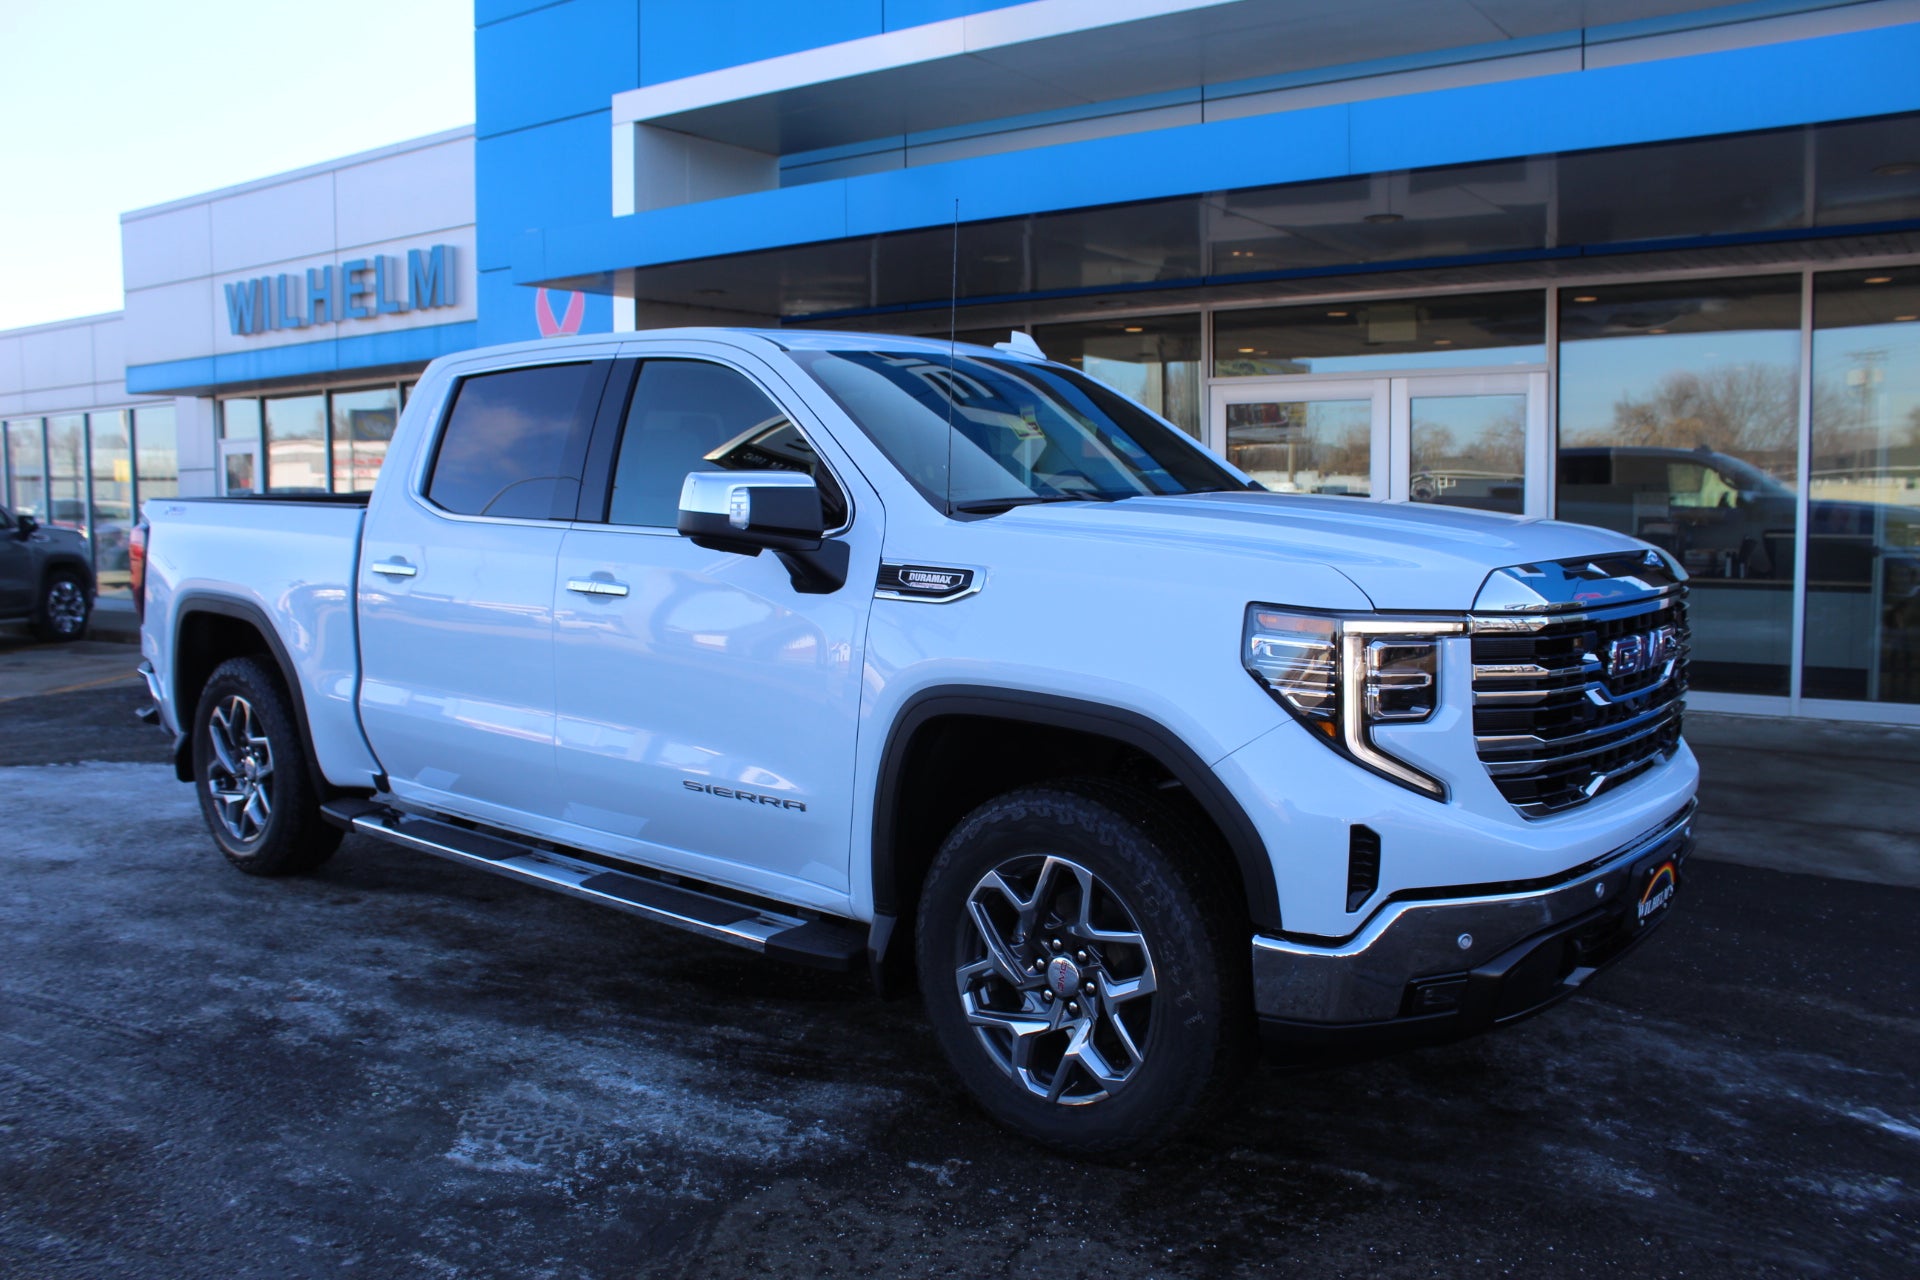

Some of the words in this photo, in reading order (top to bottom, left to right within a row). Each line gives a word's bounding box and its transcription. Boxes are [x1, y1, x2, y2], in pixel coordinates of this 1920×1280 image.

[224, 244, 456, 336] WILHELM
[908, 572, 952, 585] DURAMAX
[1608, 625, 1678, 679] GMC
[682, 780, 807, 812] SIERRA
